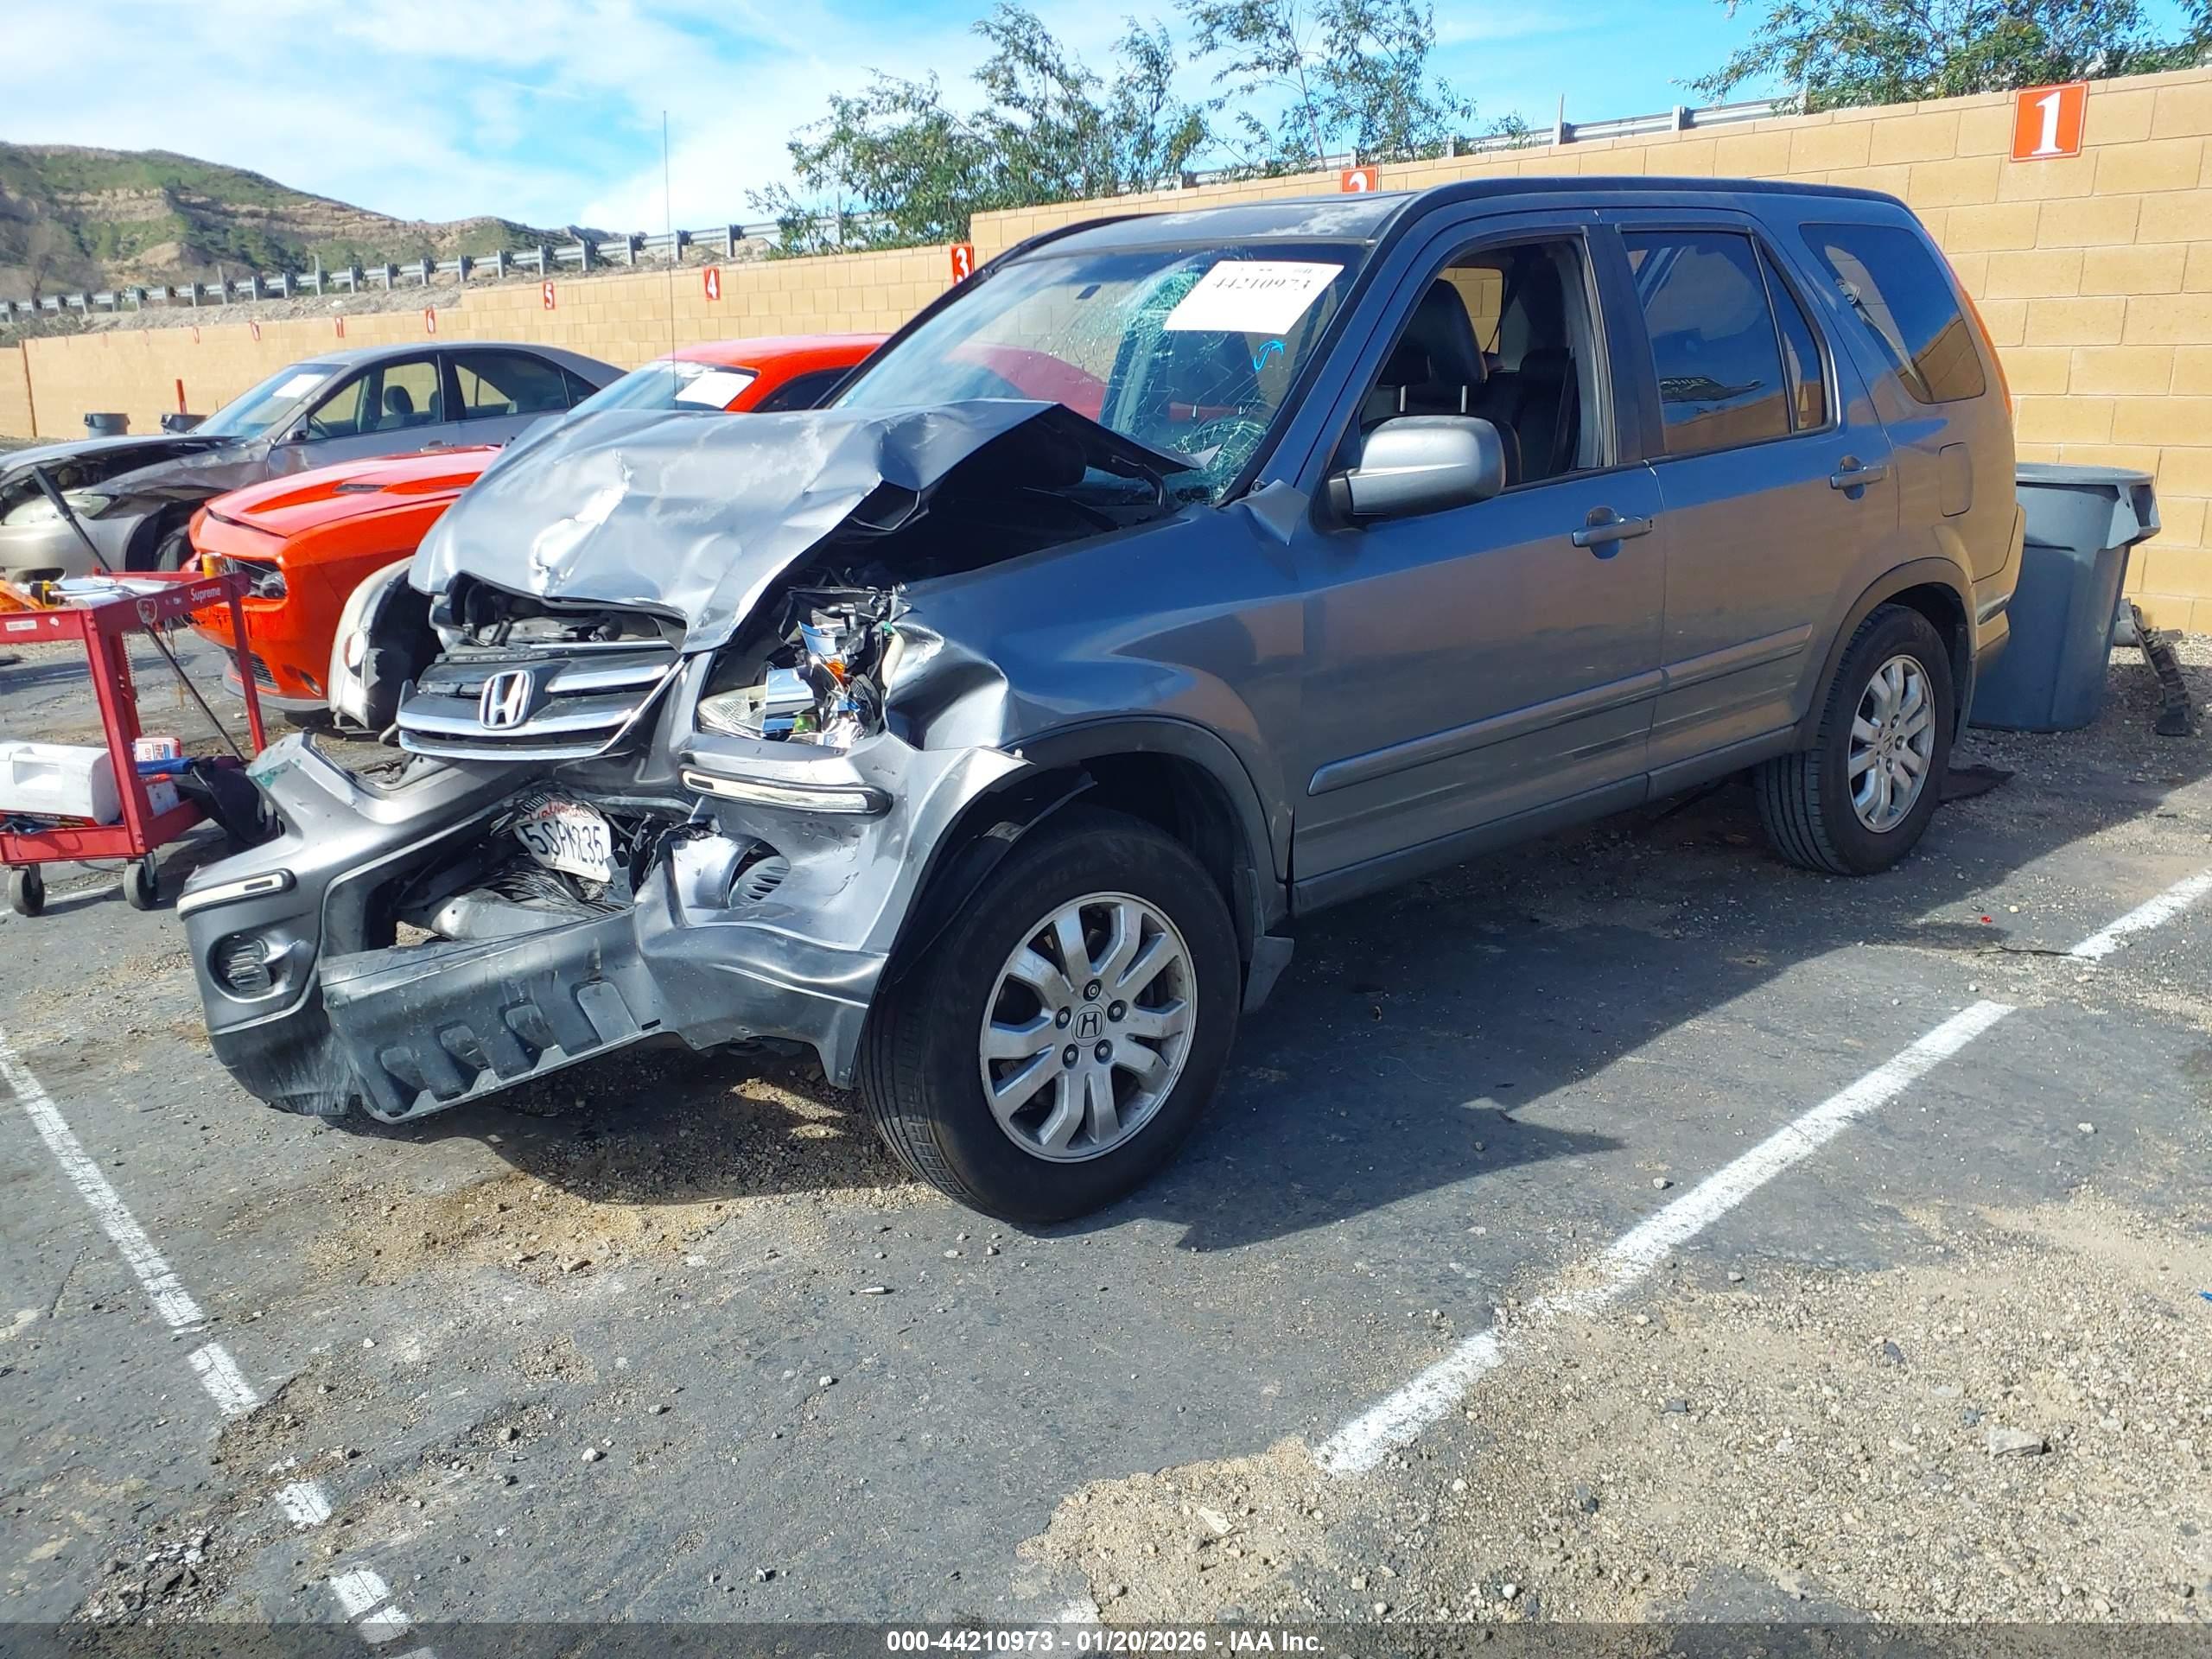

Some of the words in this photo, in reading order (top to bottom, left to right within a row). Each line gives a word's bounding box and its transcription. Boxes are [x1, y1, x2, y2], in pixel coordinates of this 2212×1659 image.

[2031, 91, 2063, 156] 1
[955, 247, 969, 284] 3
[544, 283, 553, 309] 5
[706, 269, 717, 299] 4
[427, 309, 435, 333] 6
[190, 588, 221, 604] Supreme
